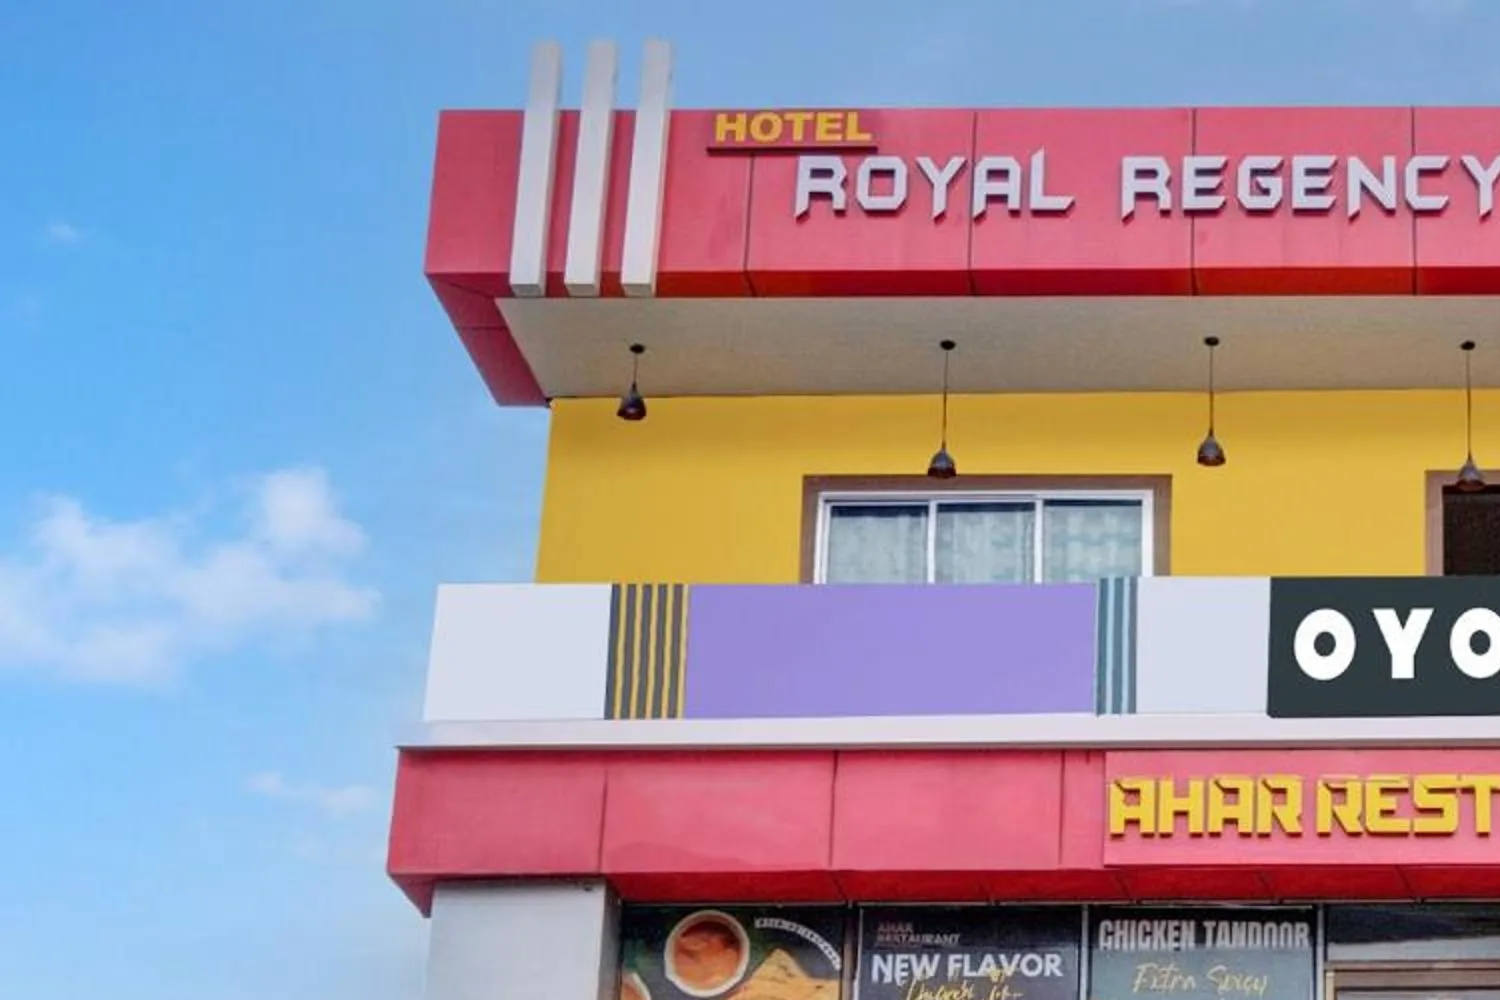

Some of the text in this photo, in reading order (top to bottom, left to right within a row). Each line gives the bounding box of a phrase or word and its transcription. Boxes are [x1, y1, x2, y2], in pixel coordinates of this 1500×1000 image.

[714, 111, 873, 144] HOTEL
[794, 147, 1076, 220] ROYAL
[1110, 773, 1303, 837] AHAR
[1099, 919, 1311, 951] CHICKEN TANDOOR
[871, 953, 1064, 986] NEW FLAVOR
